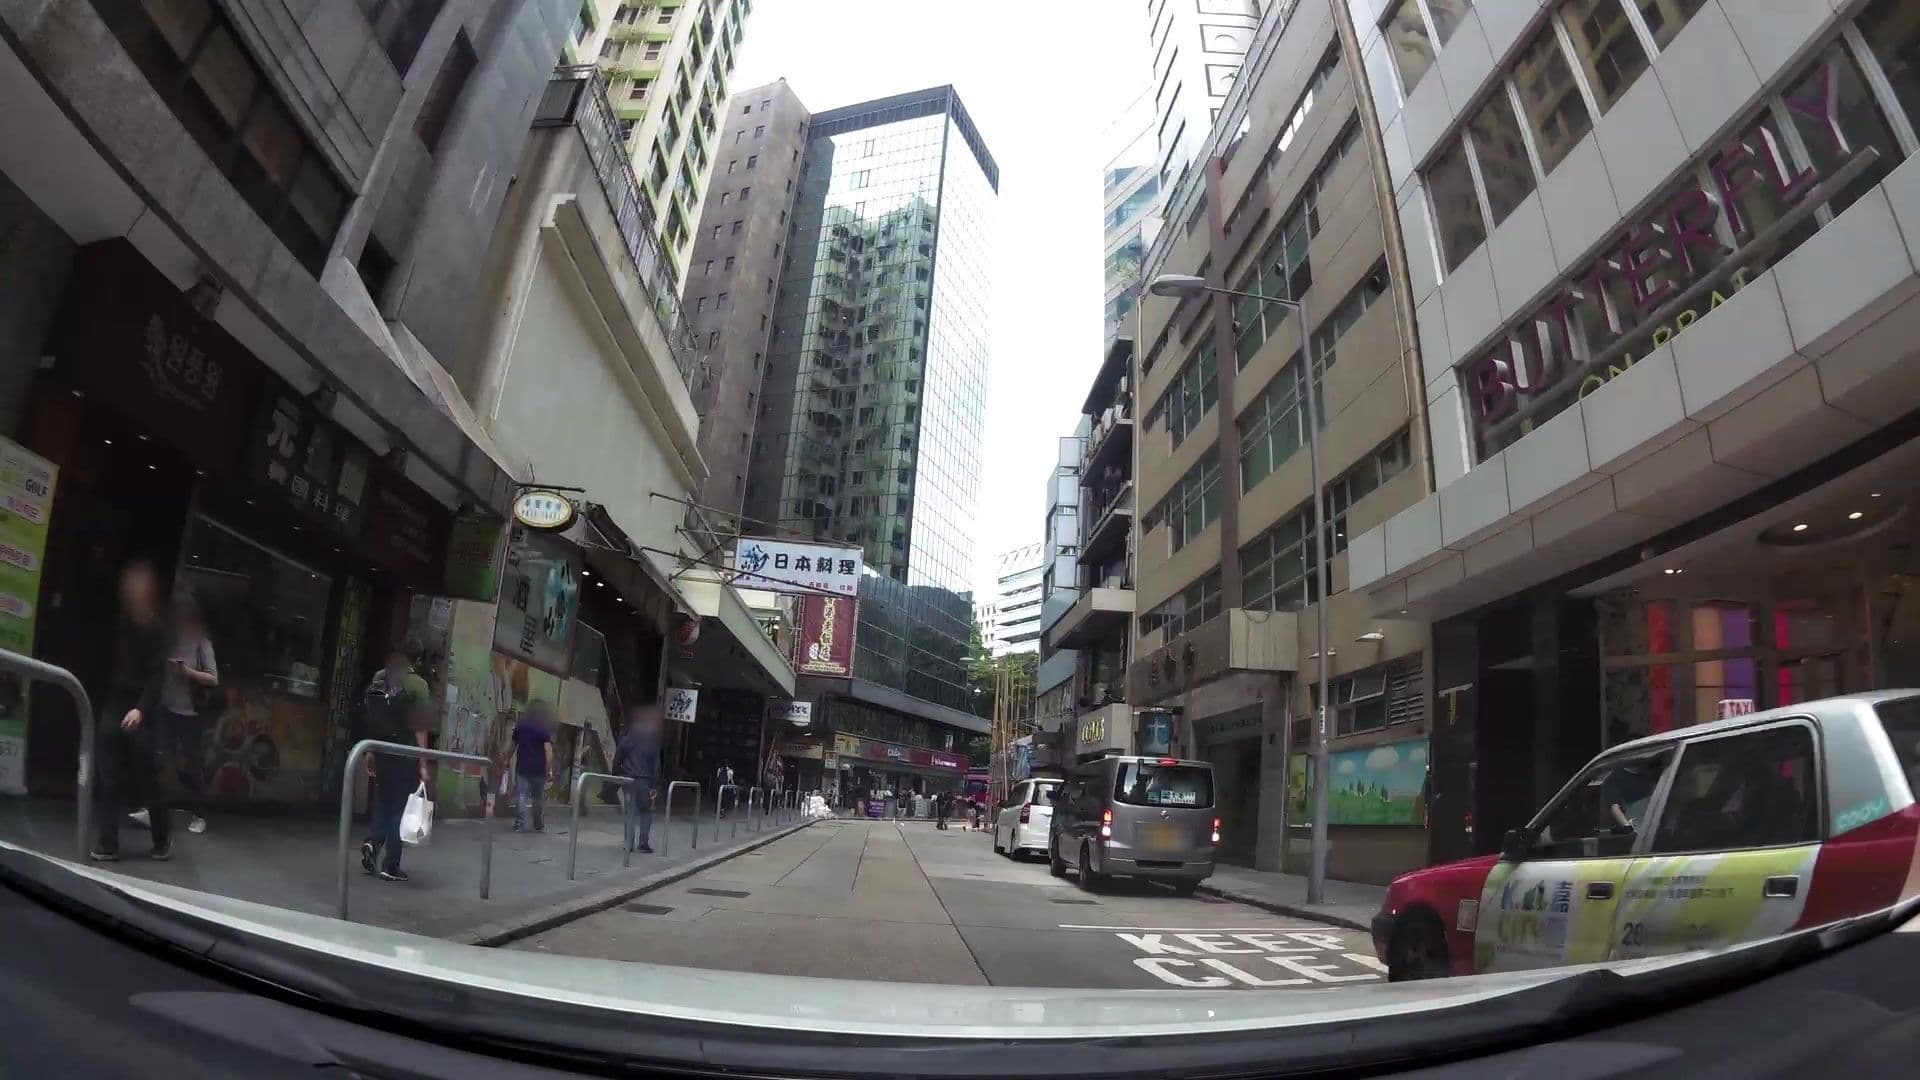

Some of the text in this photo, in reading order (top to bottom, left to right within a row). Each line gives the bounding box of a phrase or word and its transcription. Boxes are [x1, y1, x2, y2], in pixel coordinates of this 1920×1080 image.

[1475, 61, 1851, 422] BUTTERFLY
[775, 553, 855, 575] 日本料理
[1729, 701, 1752, 718] TAXI
[1116, 932, 1347, 956] KEEP
[1133, 953, 1388, 988] CLE
